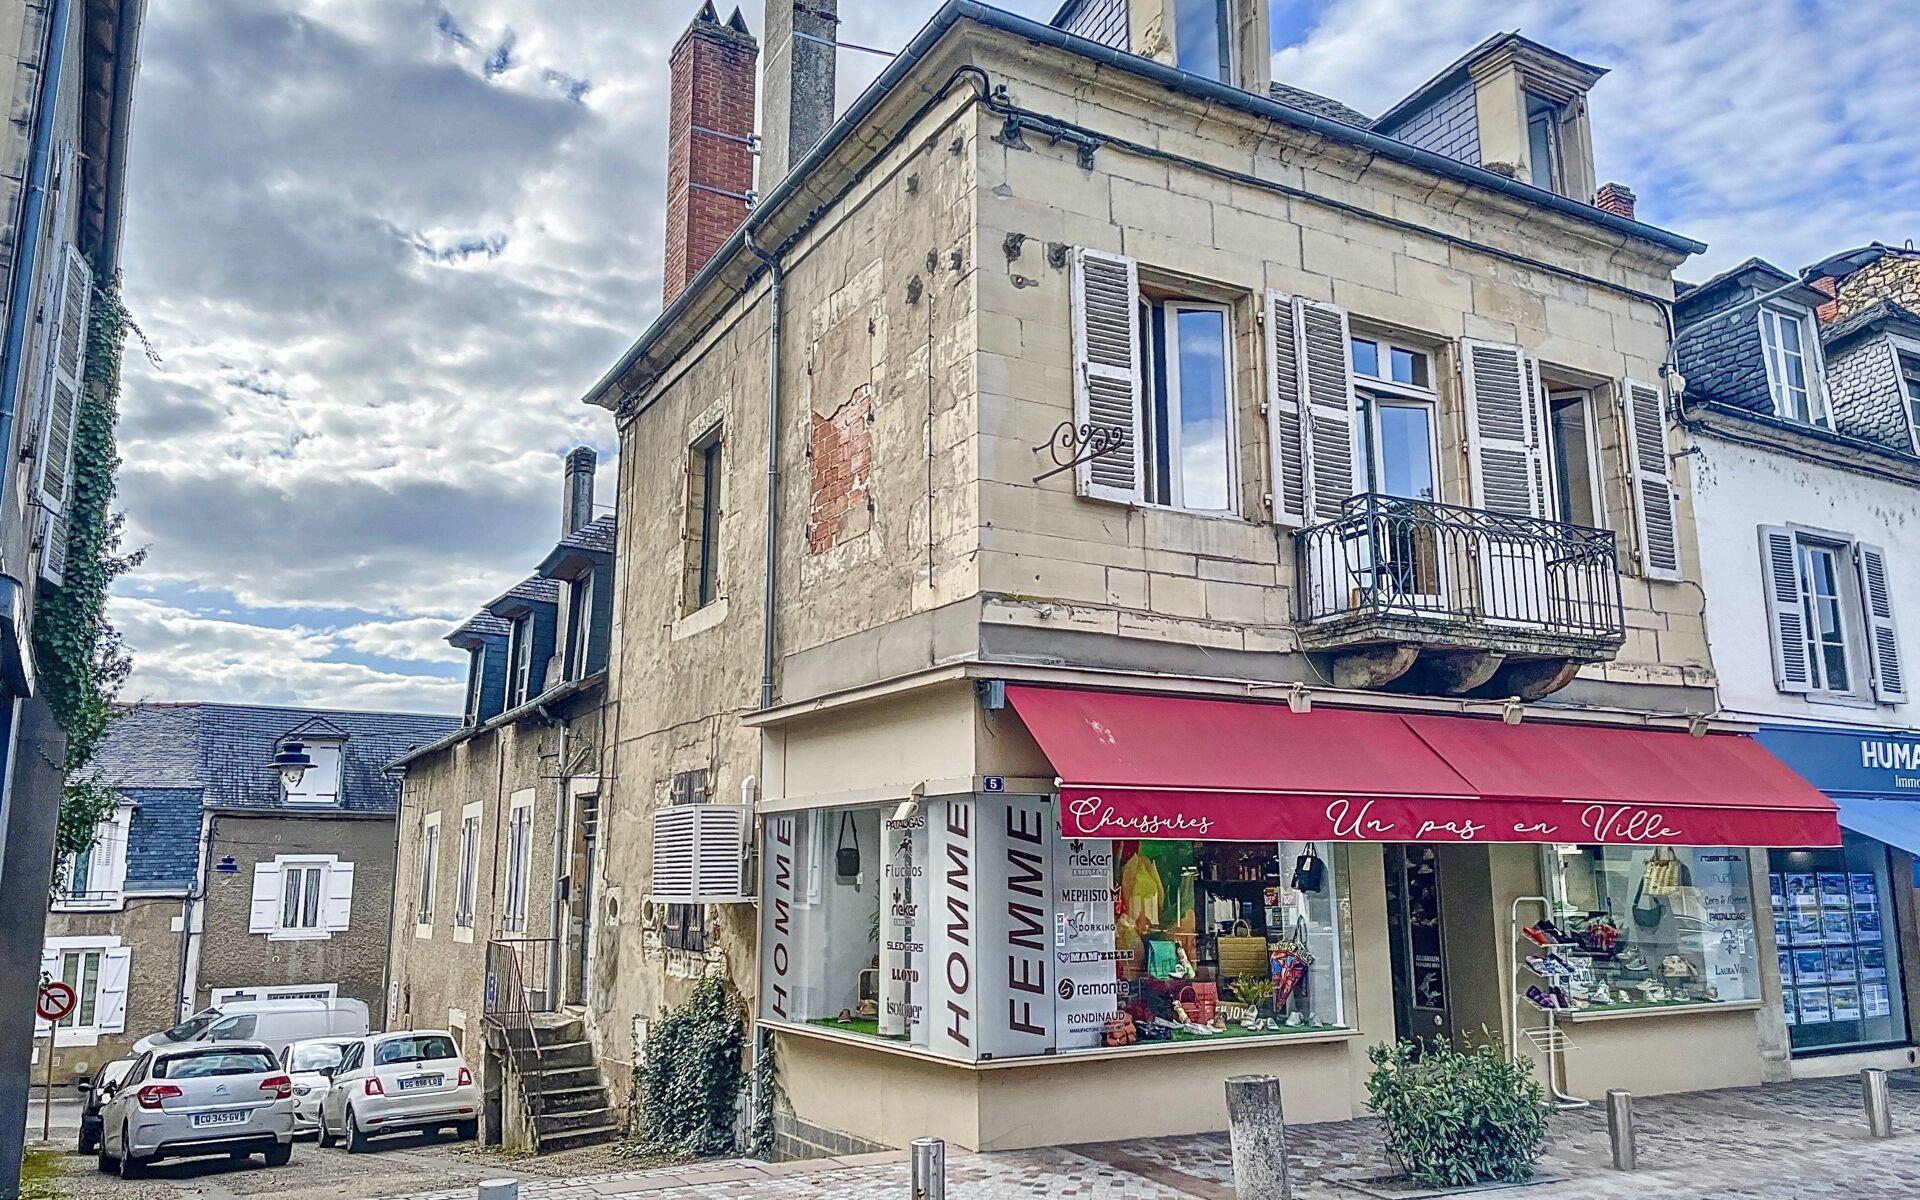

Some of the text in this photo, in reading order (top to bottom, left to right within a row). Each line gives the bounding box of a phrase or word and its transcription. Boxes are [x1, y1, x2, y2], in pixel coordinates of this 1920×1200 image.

[990, 778, 998, 790] 5
[1069, 796, 1214, 834] Chaussures
[1325, 799, 1682, 842] Un pas en Ville
[886, 816, 925, 831] PATAUGAS
[1069, 850, 1111, 866] rieker
[1062, 889, 1108, 902] MEPHISTO
[892, 899, 918, 917] rieker
[773, 817, 791, 1019] HOMME
[946, 801, 969, 1048] HOMME
[1006, 805, 1046, 1037] FEMME
[1078, 924, 1116, 932] DORKING
[886, 941, 924, 953] SLEDGERS
[892, 968, 919, 983] LLOYD
[1077, 980, 1129, 996] remonte
[1067, 1011, 1125, 1024] RONDINAUD
